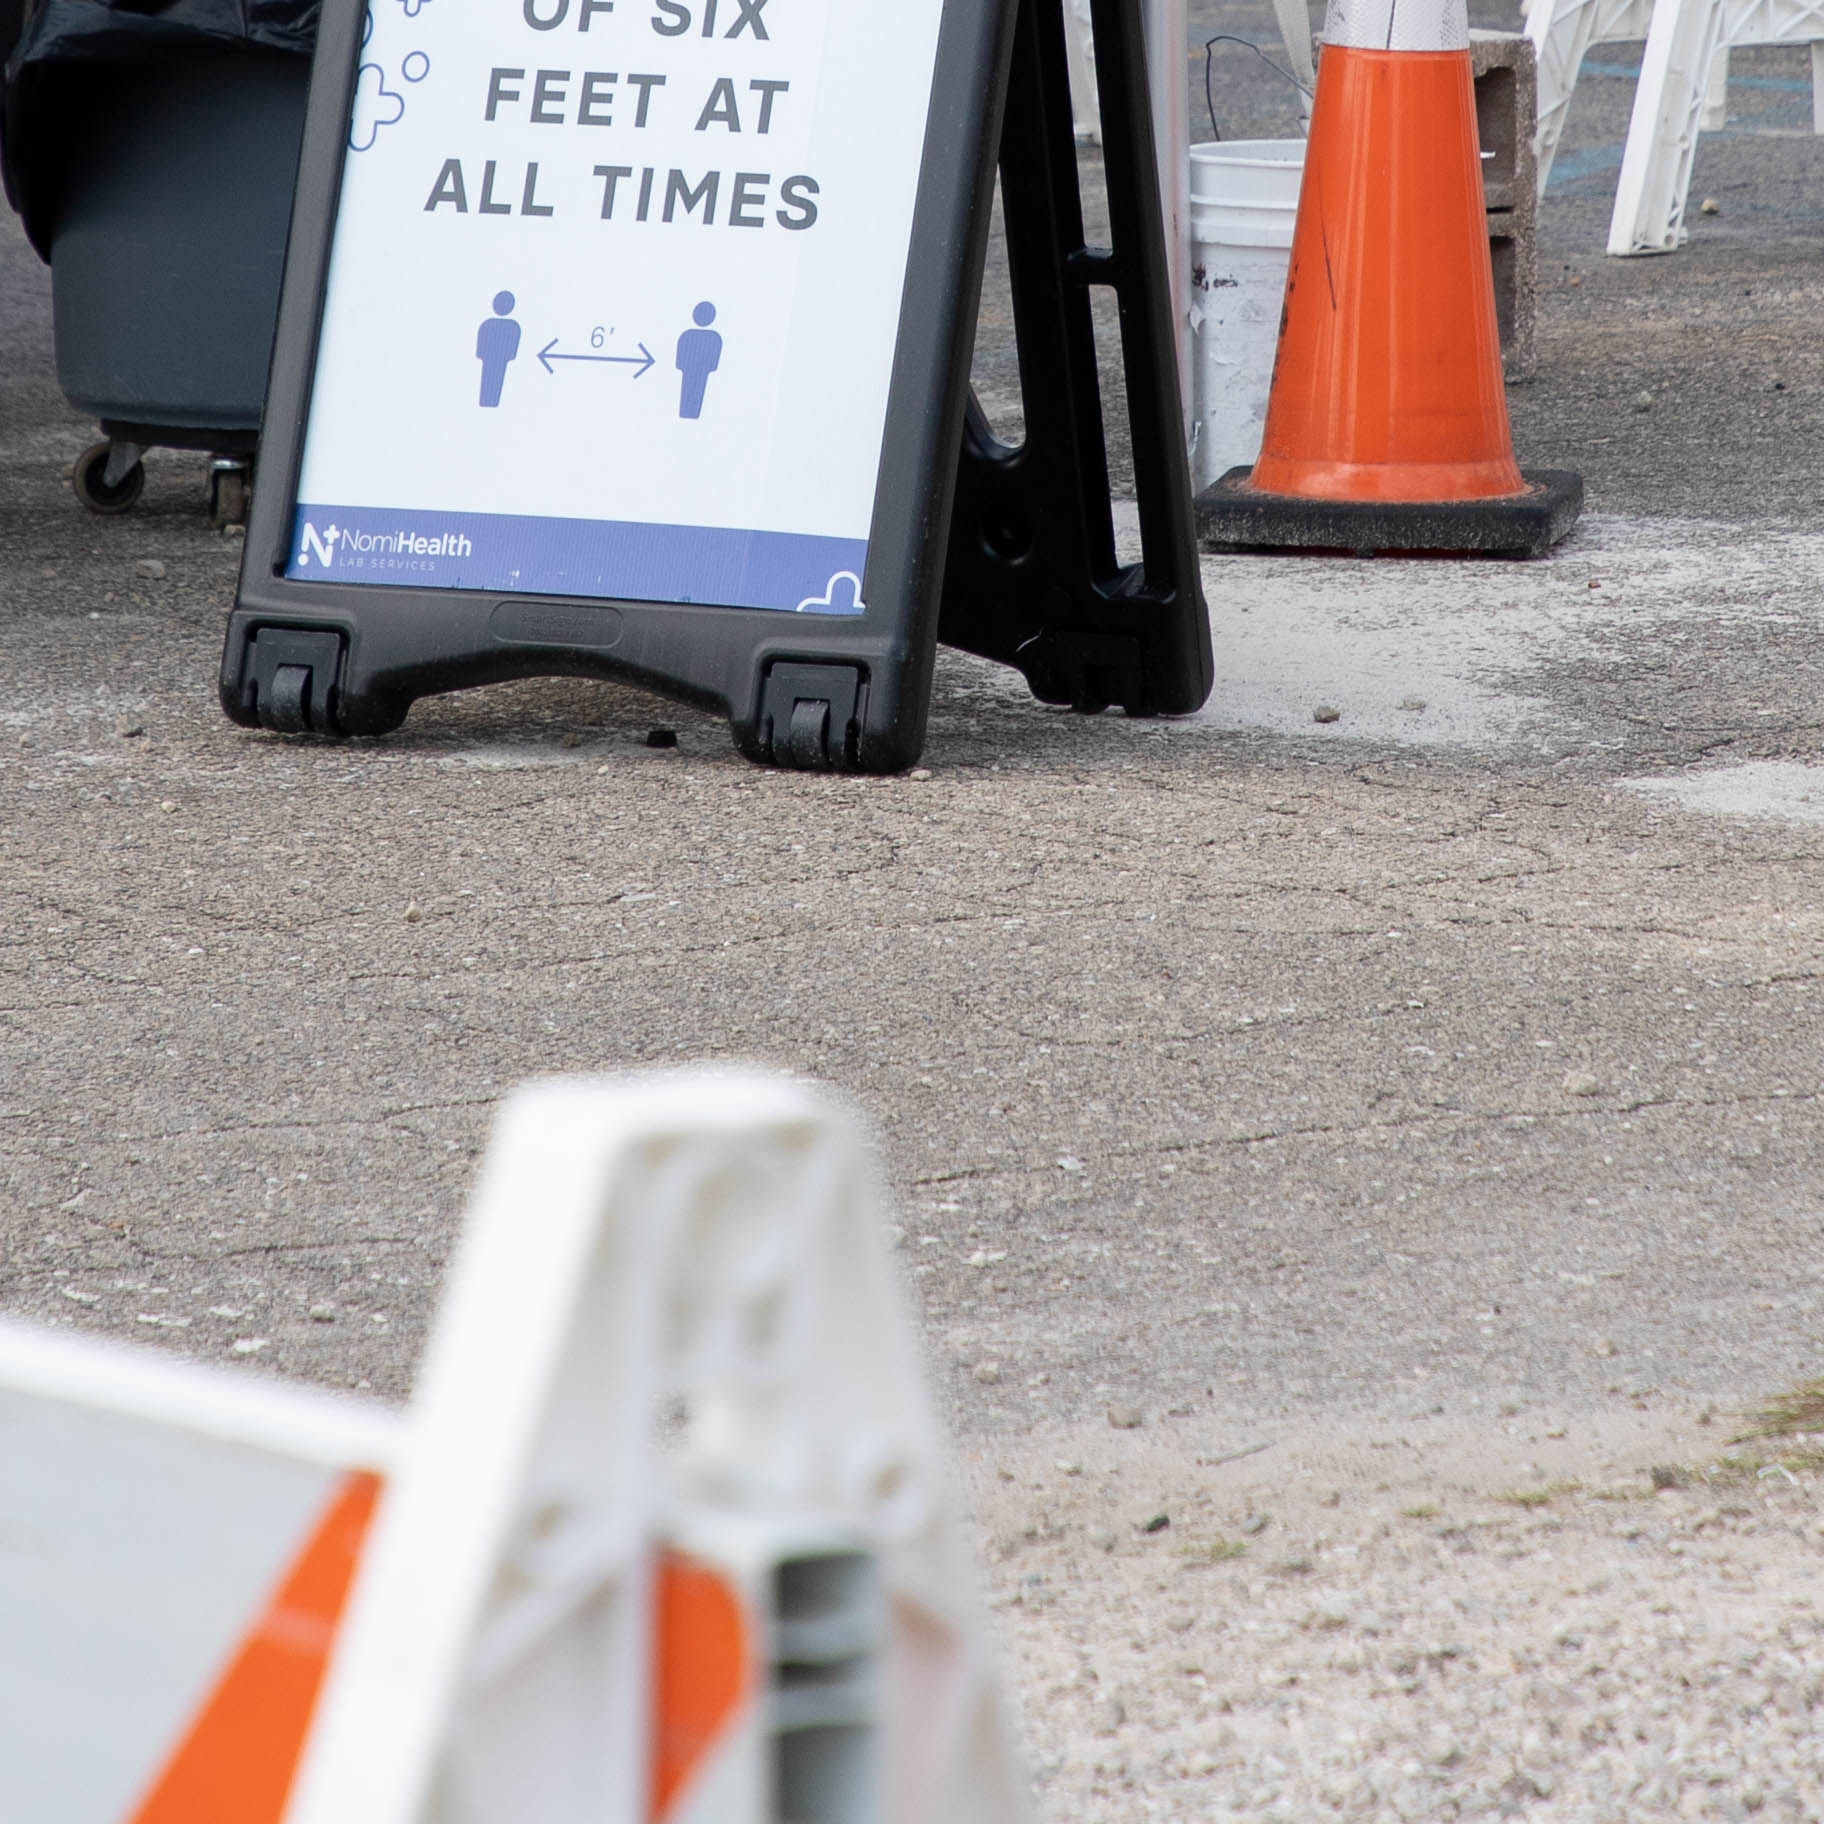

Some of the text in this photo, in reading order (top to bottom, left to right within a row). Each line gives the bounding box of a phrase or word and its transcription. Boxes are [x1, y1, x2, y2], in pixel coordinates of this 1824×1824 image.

[484, 68, 790, 135] FEET AT
[424, 159, 820, 231] ALL TIMES
[591, 326, 615, 349] 6'
[341, 528, 472, 557] NomiHealth
[339, 557, 436, 571] LAB SERVICES
